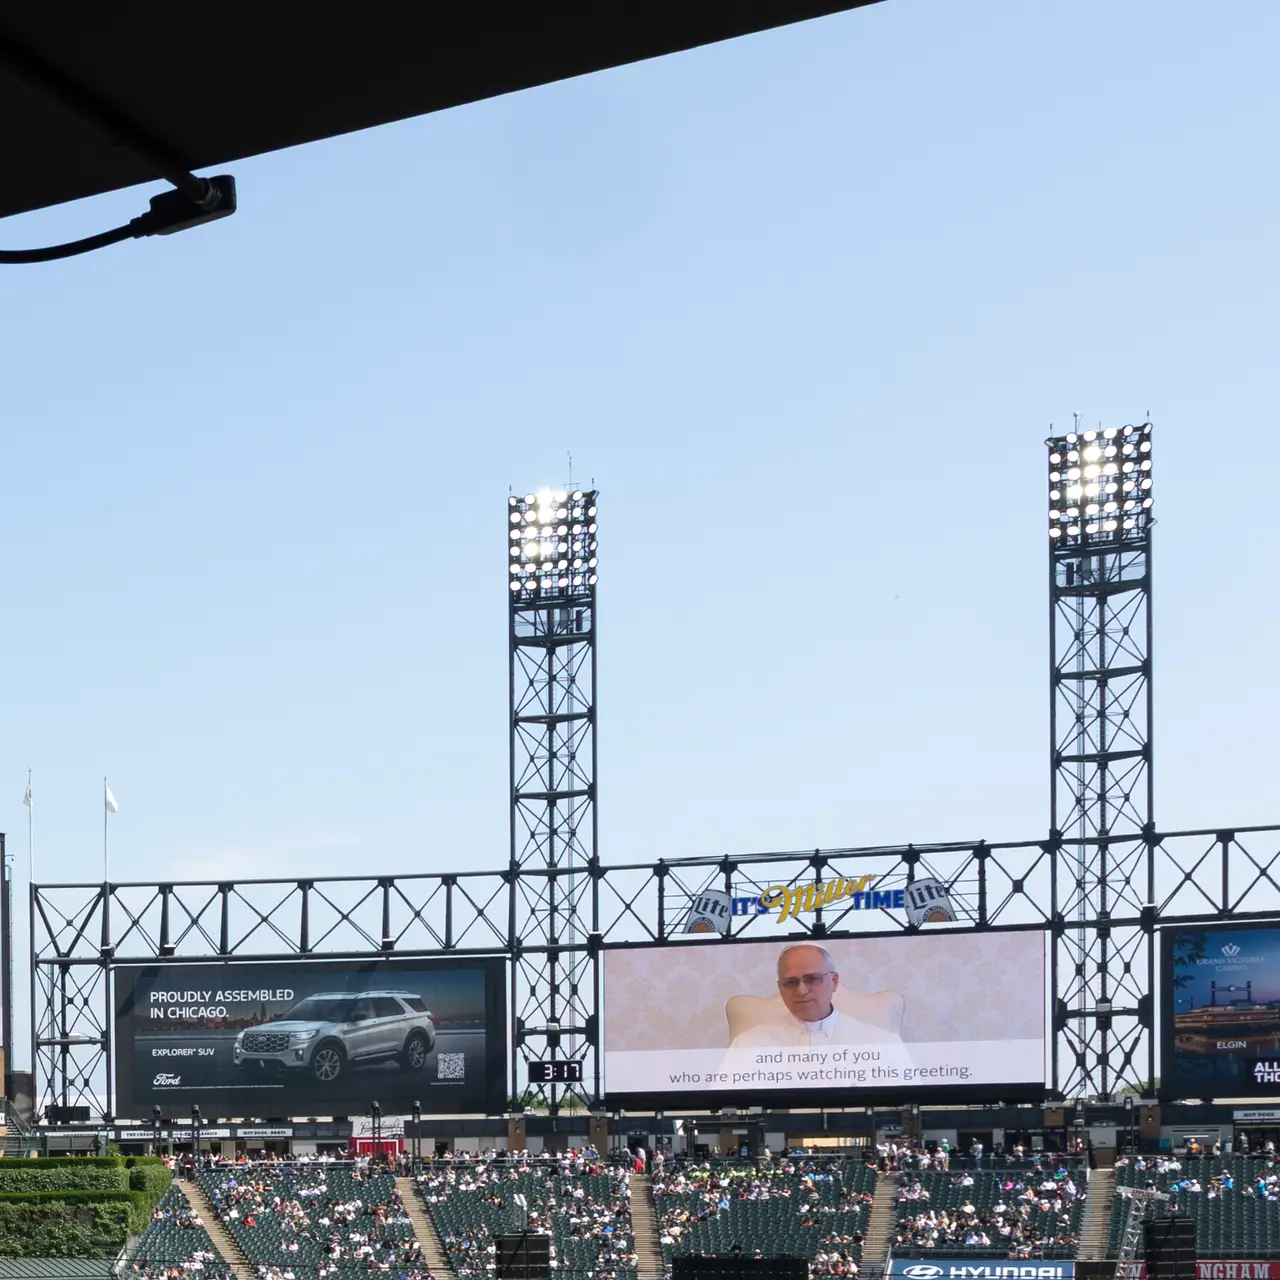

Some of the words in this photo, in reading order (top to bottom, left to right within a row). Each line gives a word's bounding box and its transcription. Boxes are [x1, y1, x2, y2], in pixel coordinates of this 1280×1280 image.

[731, 896, 769, 916] IT'S
[761, 874, 876, 923] Miller
[853, 889, 904, 910] TIME
[907, 880, 945, 910] Lite
[695, 897, 728, 919] Lite
[1197, 956, 1225, 965] GRAND
[1226, 955, 1265, 965] VICTORIA
[150, 990, 211, 1003] PROUDLY
[215, 989, 294, 1002] ASSEMBLED
[150, 1007, 164, 1019] IN
[168, 1006, 230, 1019] CHICAGO.
[197, 1047, 215, 1056] SUV
[1217, 1041, 1247, 1049] ELGIN
[756, 1050, 782, 1064] and
[787, 1052, 827, 1066] many
[832, 1049, 849, 1062] of
[852, 1050, 880, 1064] you
[153, 1072, 181, 1086] Ford
[544, 1064, 581, 1080] 3:17
[669, 1071, 701, 1083] who
[705, 1073, 728, 1083] are
[733, 1070, 793, 1085] perhaps
[797, 1067, 866, 1082] watching
[871, 1066, 899, 1079] this
[903, 1064, 973, 1080] greeting.
[949, 1266, 1063, 1280] HYUNDAI
